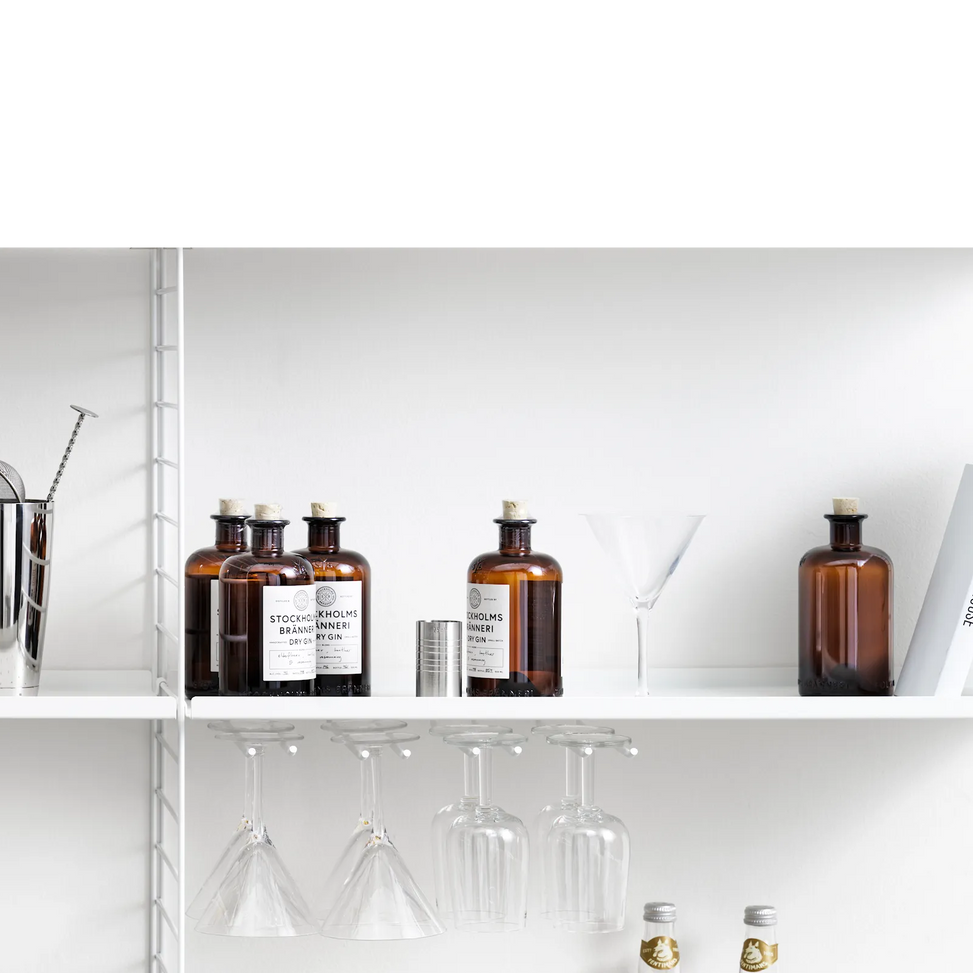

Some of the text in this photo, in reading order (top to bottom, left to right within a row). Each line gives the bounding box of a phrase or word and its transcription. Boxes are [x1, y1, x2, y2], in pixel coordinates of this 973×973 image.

[269, 613, 315, 623] STOCKHOL
[316, 610, 358, 618] KHOLMS
[316, 619, 350, 630] ÄNNERI
[316, 633, 327, 641] RY
[327, 633, 343, 641] GIN
[289, 638, 302, 646] DRY
